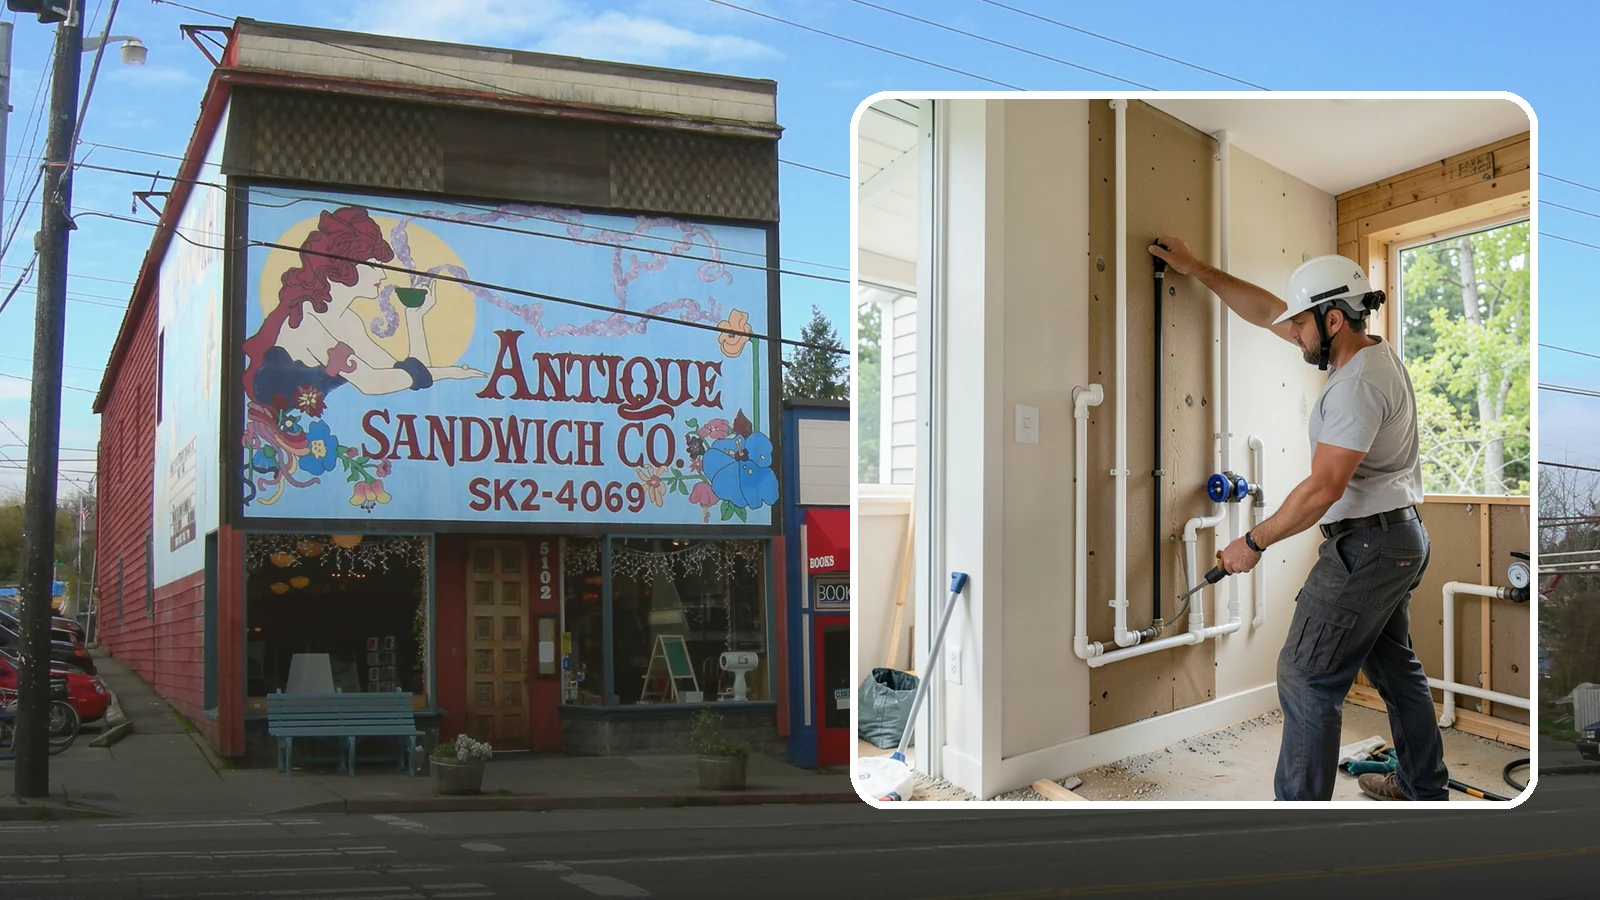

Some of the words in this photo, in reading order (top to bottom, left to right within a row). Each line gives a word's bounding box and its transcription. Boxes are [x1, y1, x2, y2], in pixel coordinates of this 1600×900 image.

[476, 329, 723, 420] ANTIQUE
[361, 408, 604, 467] SANDWICH
[617, 421, 685, 469] CO.
[468, 476, 646, 514] SK2-4069
[539, 541, 552, 600] 5102
[809, 555, 835, 569] BOOKS
